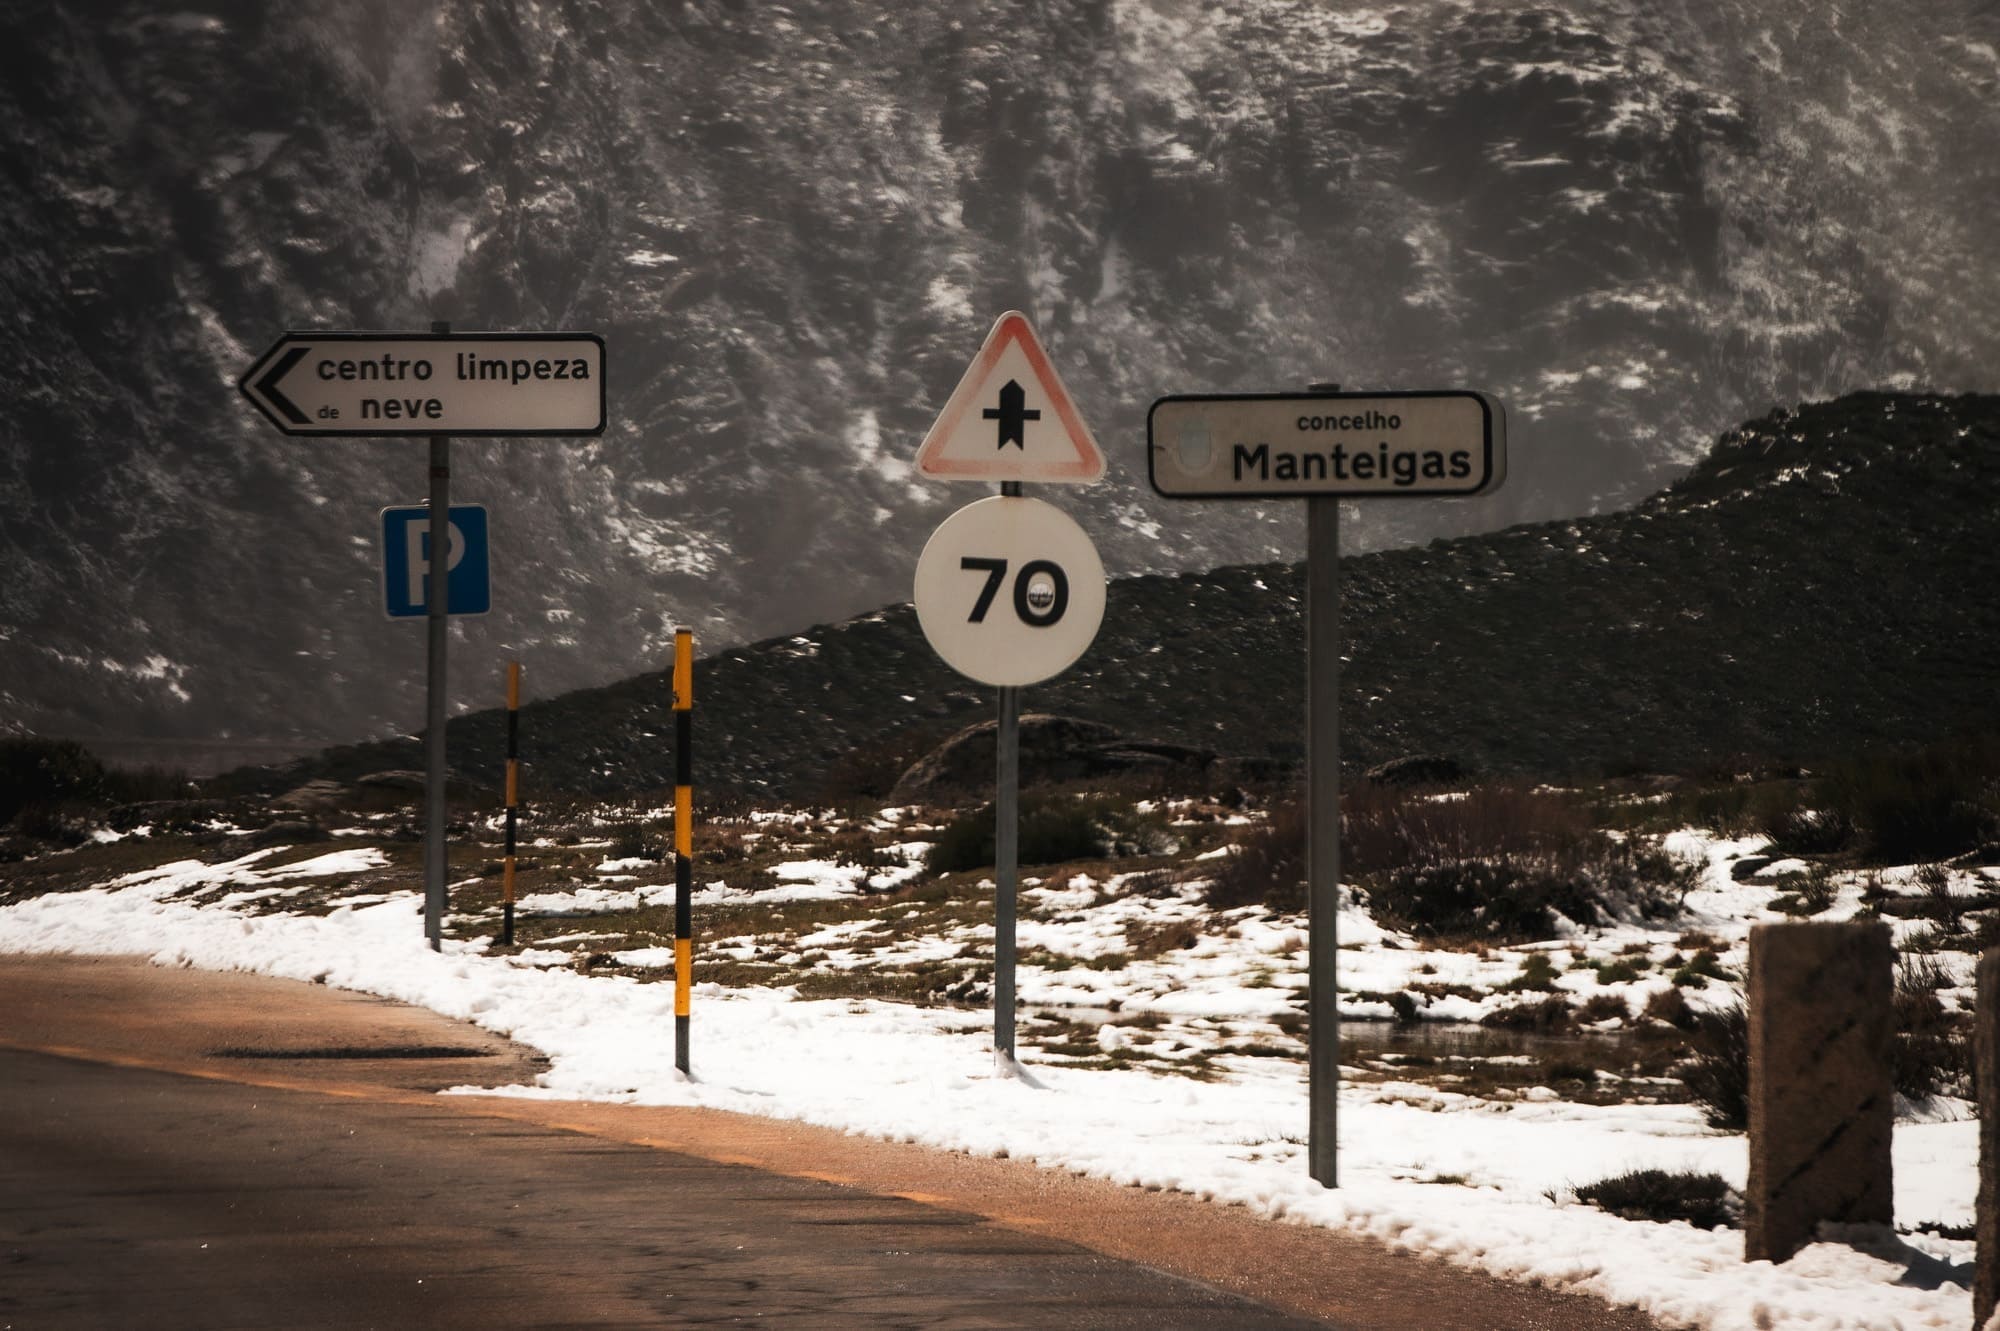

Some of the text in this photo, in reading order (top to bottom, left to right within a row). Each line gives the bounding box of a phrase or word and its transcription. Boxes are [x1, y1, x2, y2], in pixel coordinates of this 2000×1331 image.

[317, 352, 590, 385] centro limpeza
[318, 398, 443, 419] de neve
[1297, 410, 1401, 431] concelho
[1233, 442, 1471, 486] Manteigas
[406, 519, 465, 606] P
[961, 556, 1069, 628] 70
